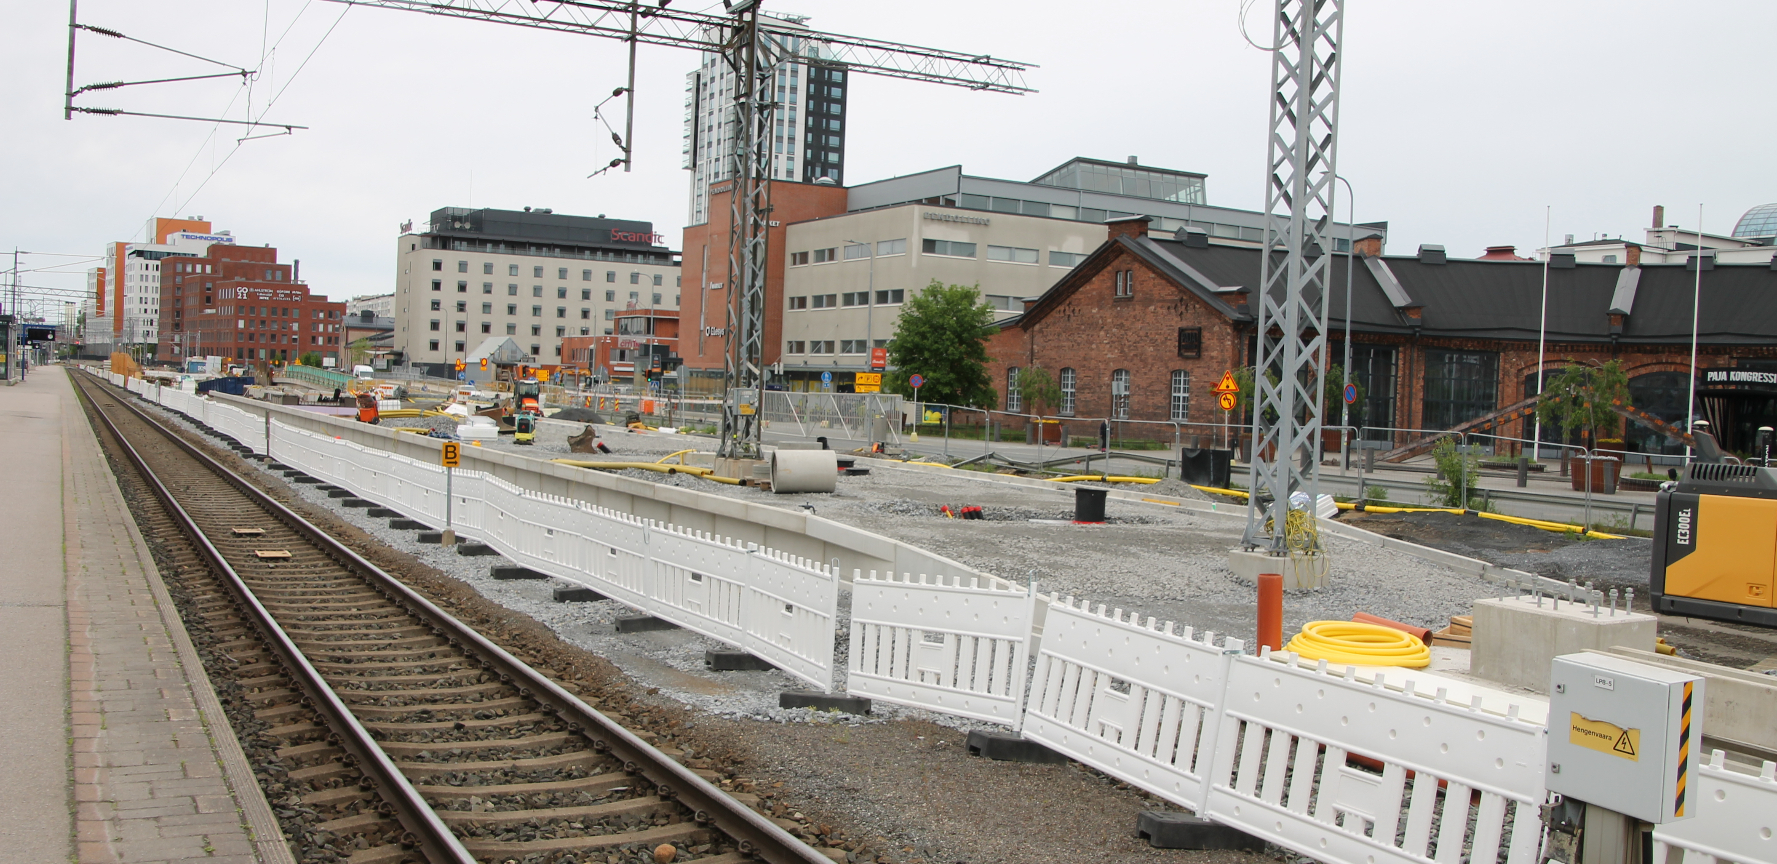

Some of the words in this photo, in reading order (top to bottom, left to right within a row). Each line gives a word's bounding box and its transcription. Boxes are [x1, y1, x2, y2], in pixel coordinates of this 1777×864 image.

[181, 234, 233, 242] TECHNOPOLIS
[611, 228, 665, 244] Scandic
[1707, 371, 1728, 382] PAJA
[1730, 371, 1777, 384] KONGRESSI
[445, 445, 457, 459] B
[1572, 725, 1612, 741] Hengenvaara
